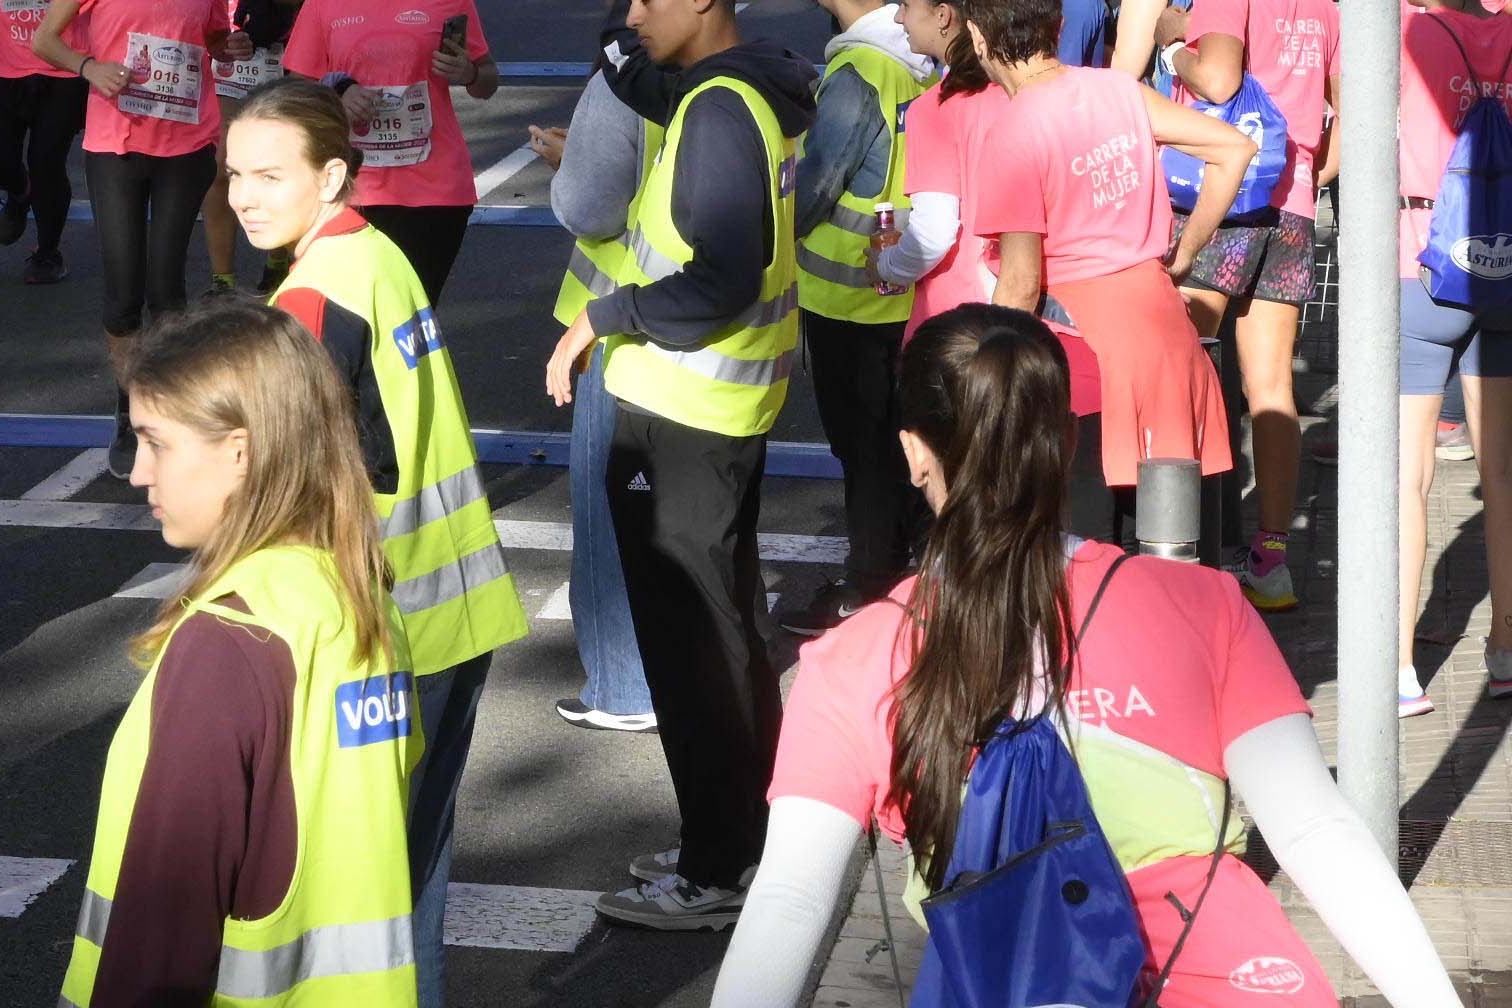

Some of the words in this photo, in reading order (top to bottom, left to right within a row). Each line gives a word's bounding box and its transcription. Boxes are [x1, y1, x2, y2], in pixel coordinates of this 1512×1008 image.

[1302, 35, 1320, 51] LA
[153, 69, 180, 84] 016
[236, 65, 260, 76] 016
[372, 117, 402, 130] 016
[377, 132, 398, 141] 3135
[1091, 166, 1111, 189] DE
[1113, 155, 1134, 176] LA
[1092, 172, 1141, 209] MUJER
